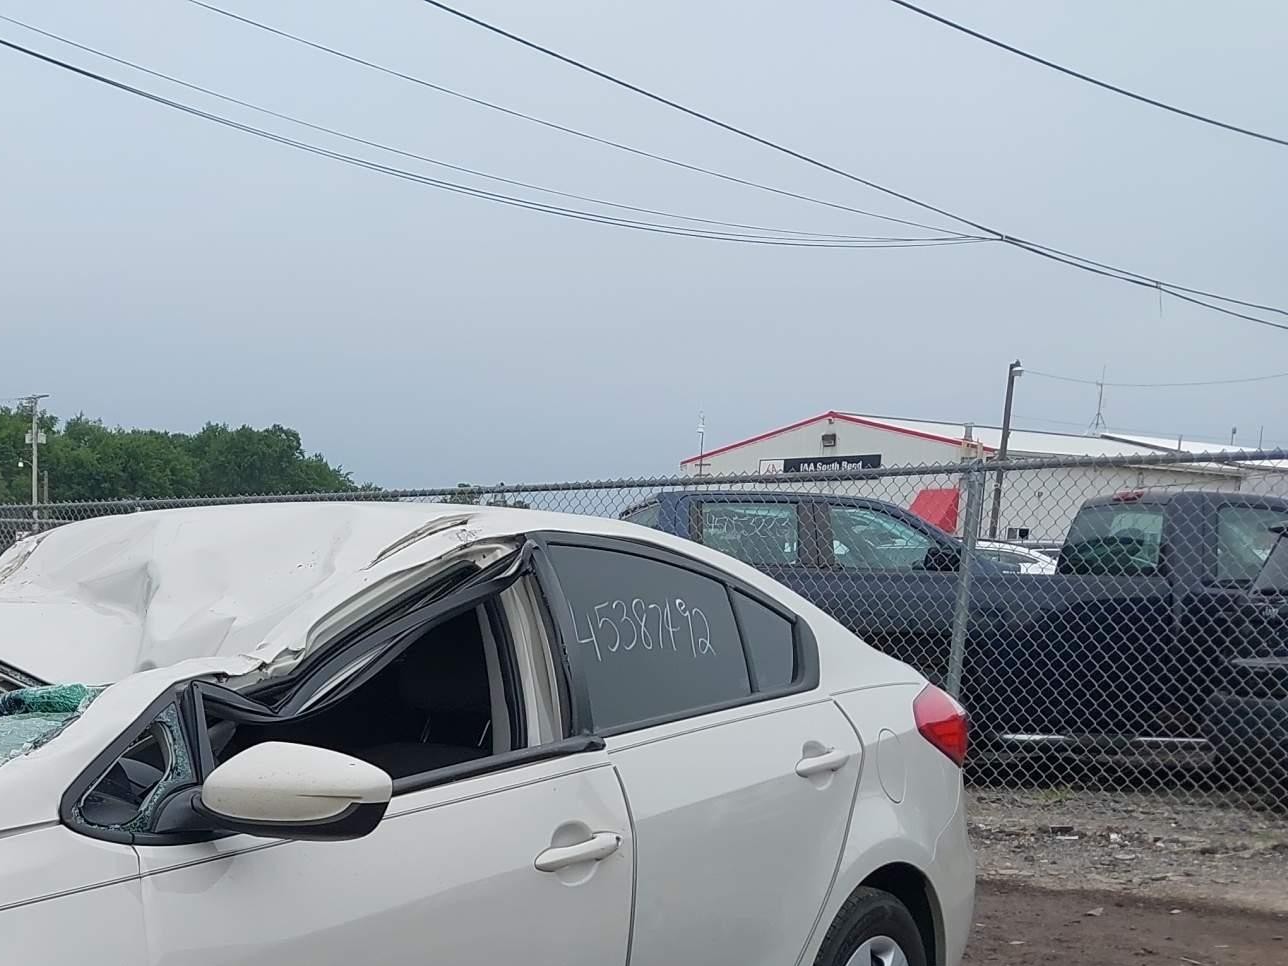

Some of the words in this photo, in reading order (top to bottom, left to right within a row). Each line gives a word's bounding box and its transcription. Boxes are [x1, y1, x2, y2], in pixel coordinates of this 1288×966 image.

[800, 462, 815, 472] IAA
[816, 461, 840, 472] South
[568, 598, 717, 662] 45387492
